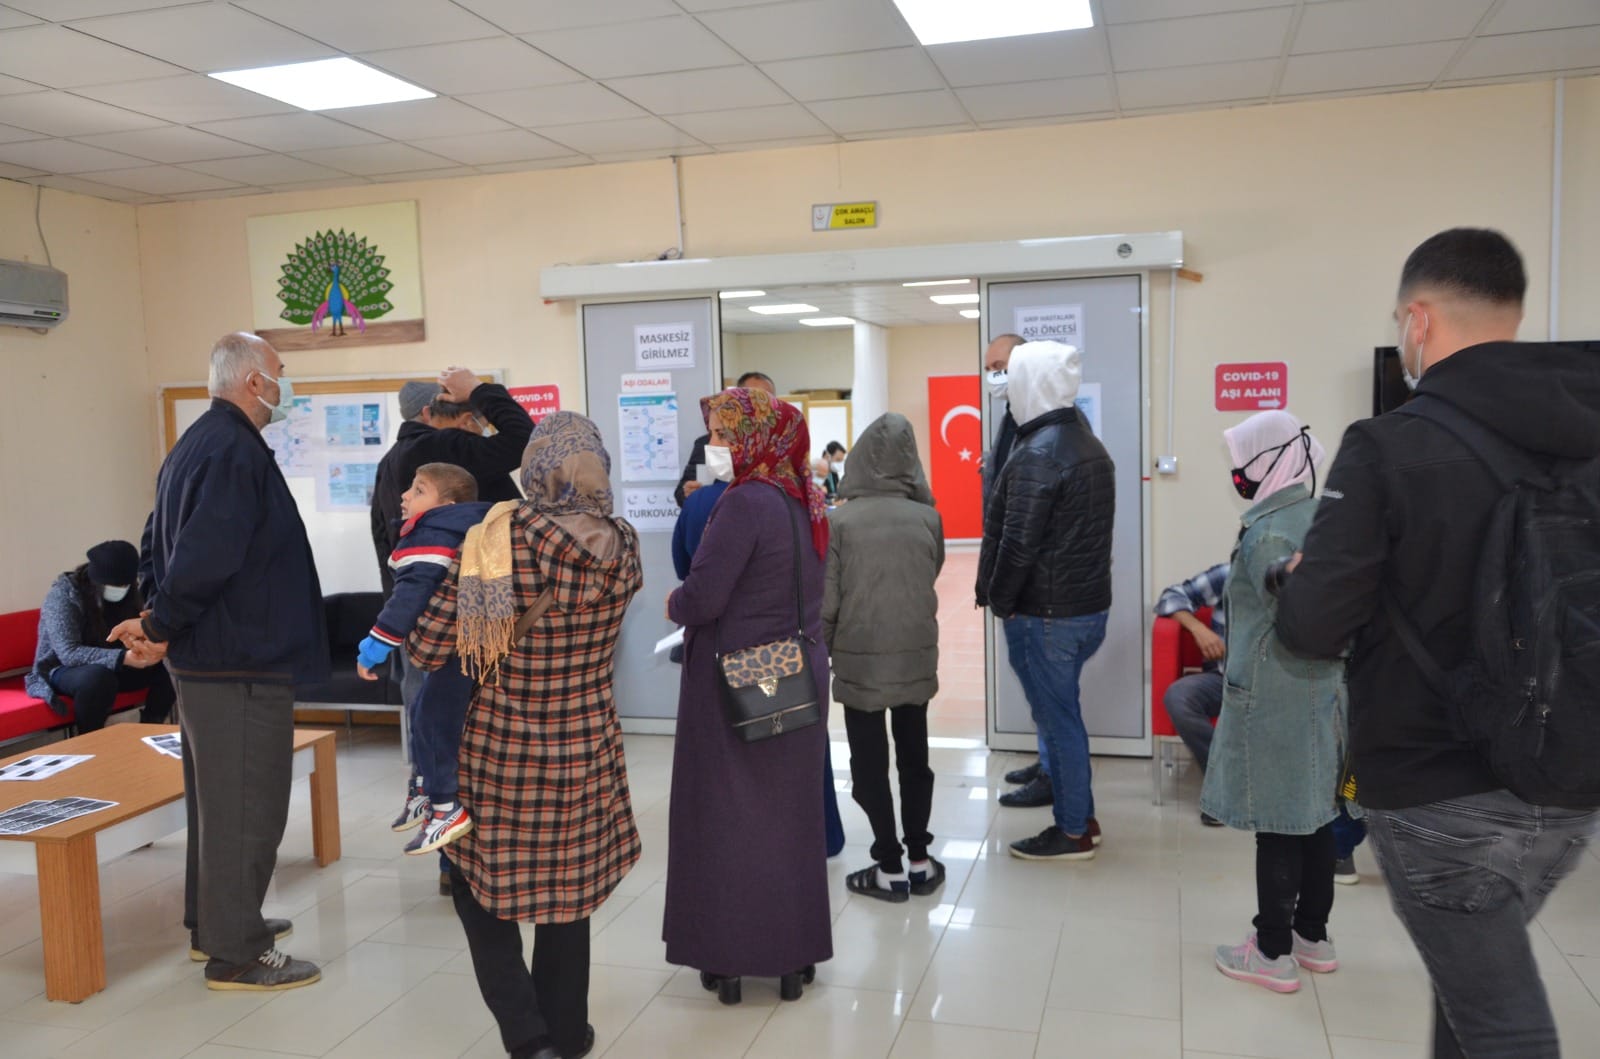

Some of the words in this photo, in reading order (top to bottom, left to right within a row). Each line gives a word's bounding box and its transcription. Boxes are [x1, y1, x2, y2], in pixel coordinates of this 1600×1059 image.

[1023, 326, 1038, 337] AŞI
[1040, 322, 1077, 335] ÖNCESİ
[639, 330, 690, 344] MASKESİZ
[641, 347, 689, 360] GİRİLMEZ
[1223, 371, 1279, 382] COVID-19
[1220, 388, 1241, 399] AŞI
[1244, 387, 1281, 398] ALANI
[628, 508, 681, 518] TURKOVAC
